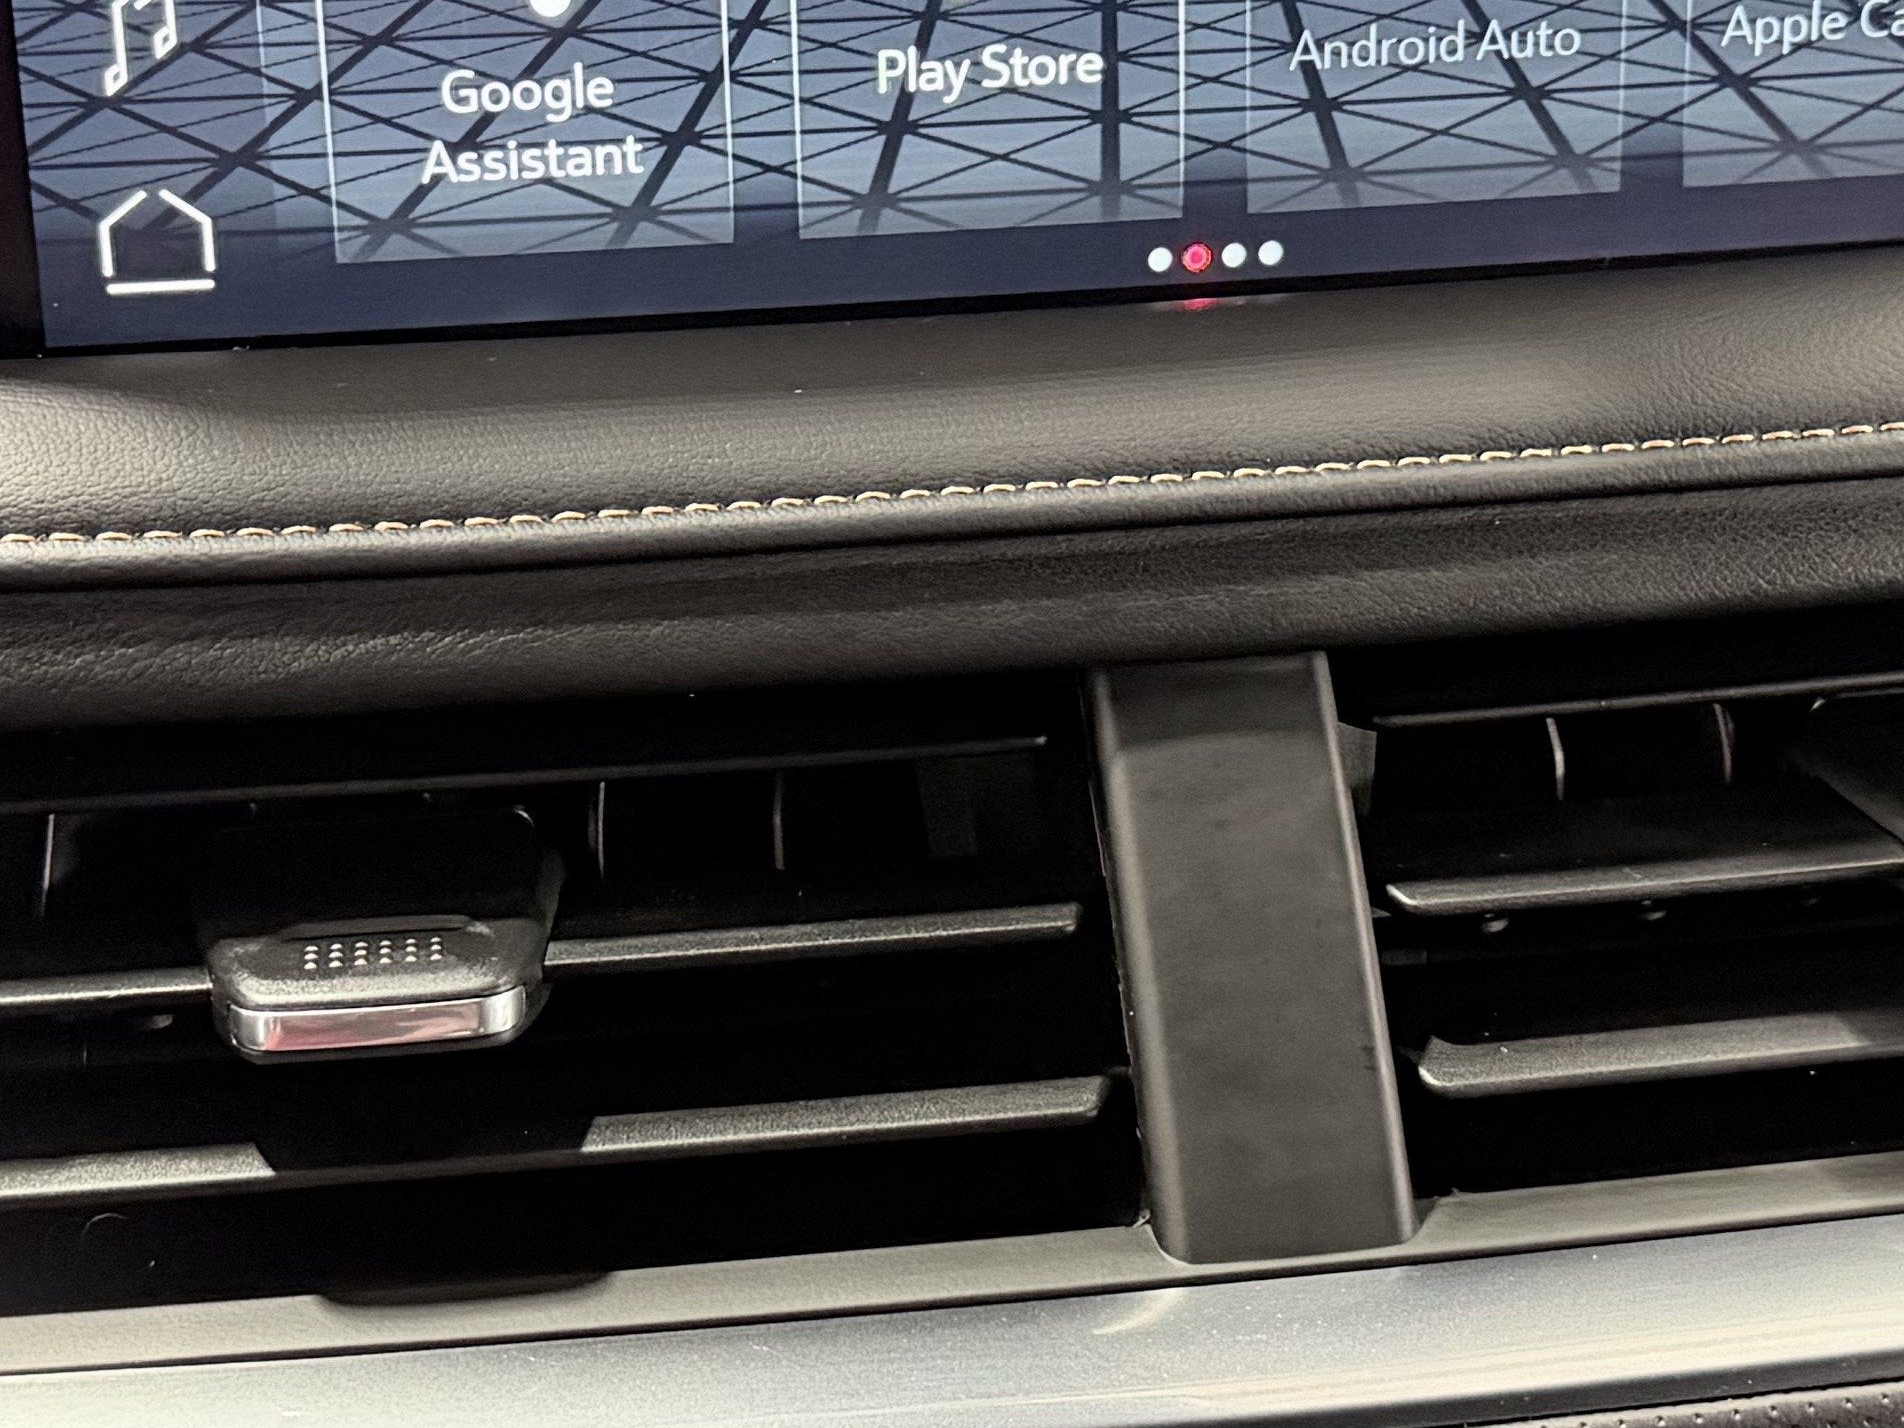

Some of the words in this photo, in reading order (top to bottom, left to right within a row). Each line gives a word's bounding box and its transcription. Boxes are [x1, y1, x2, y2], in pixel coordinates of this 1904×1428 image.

[876, 44, 972, 105] Play
[980, 42, 1105, 89] Store
[1288, 17, 1466, 73] Android
[1474, 18, 1582, 62] Auto
[440, 60, 616, 124] Google
[420, 133, 646, 185] Assistant
